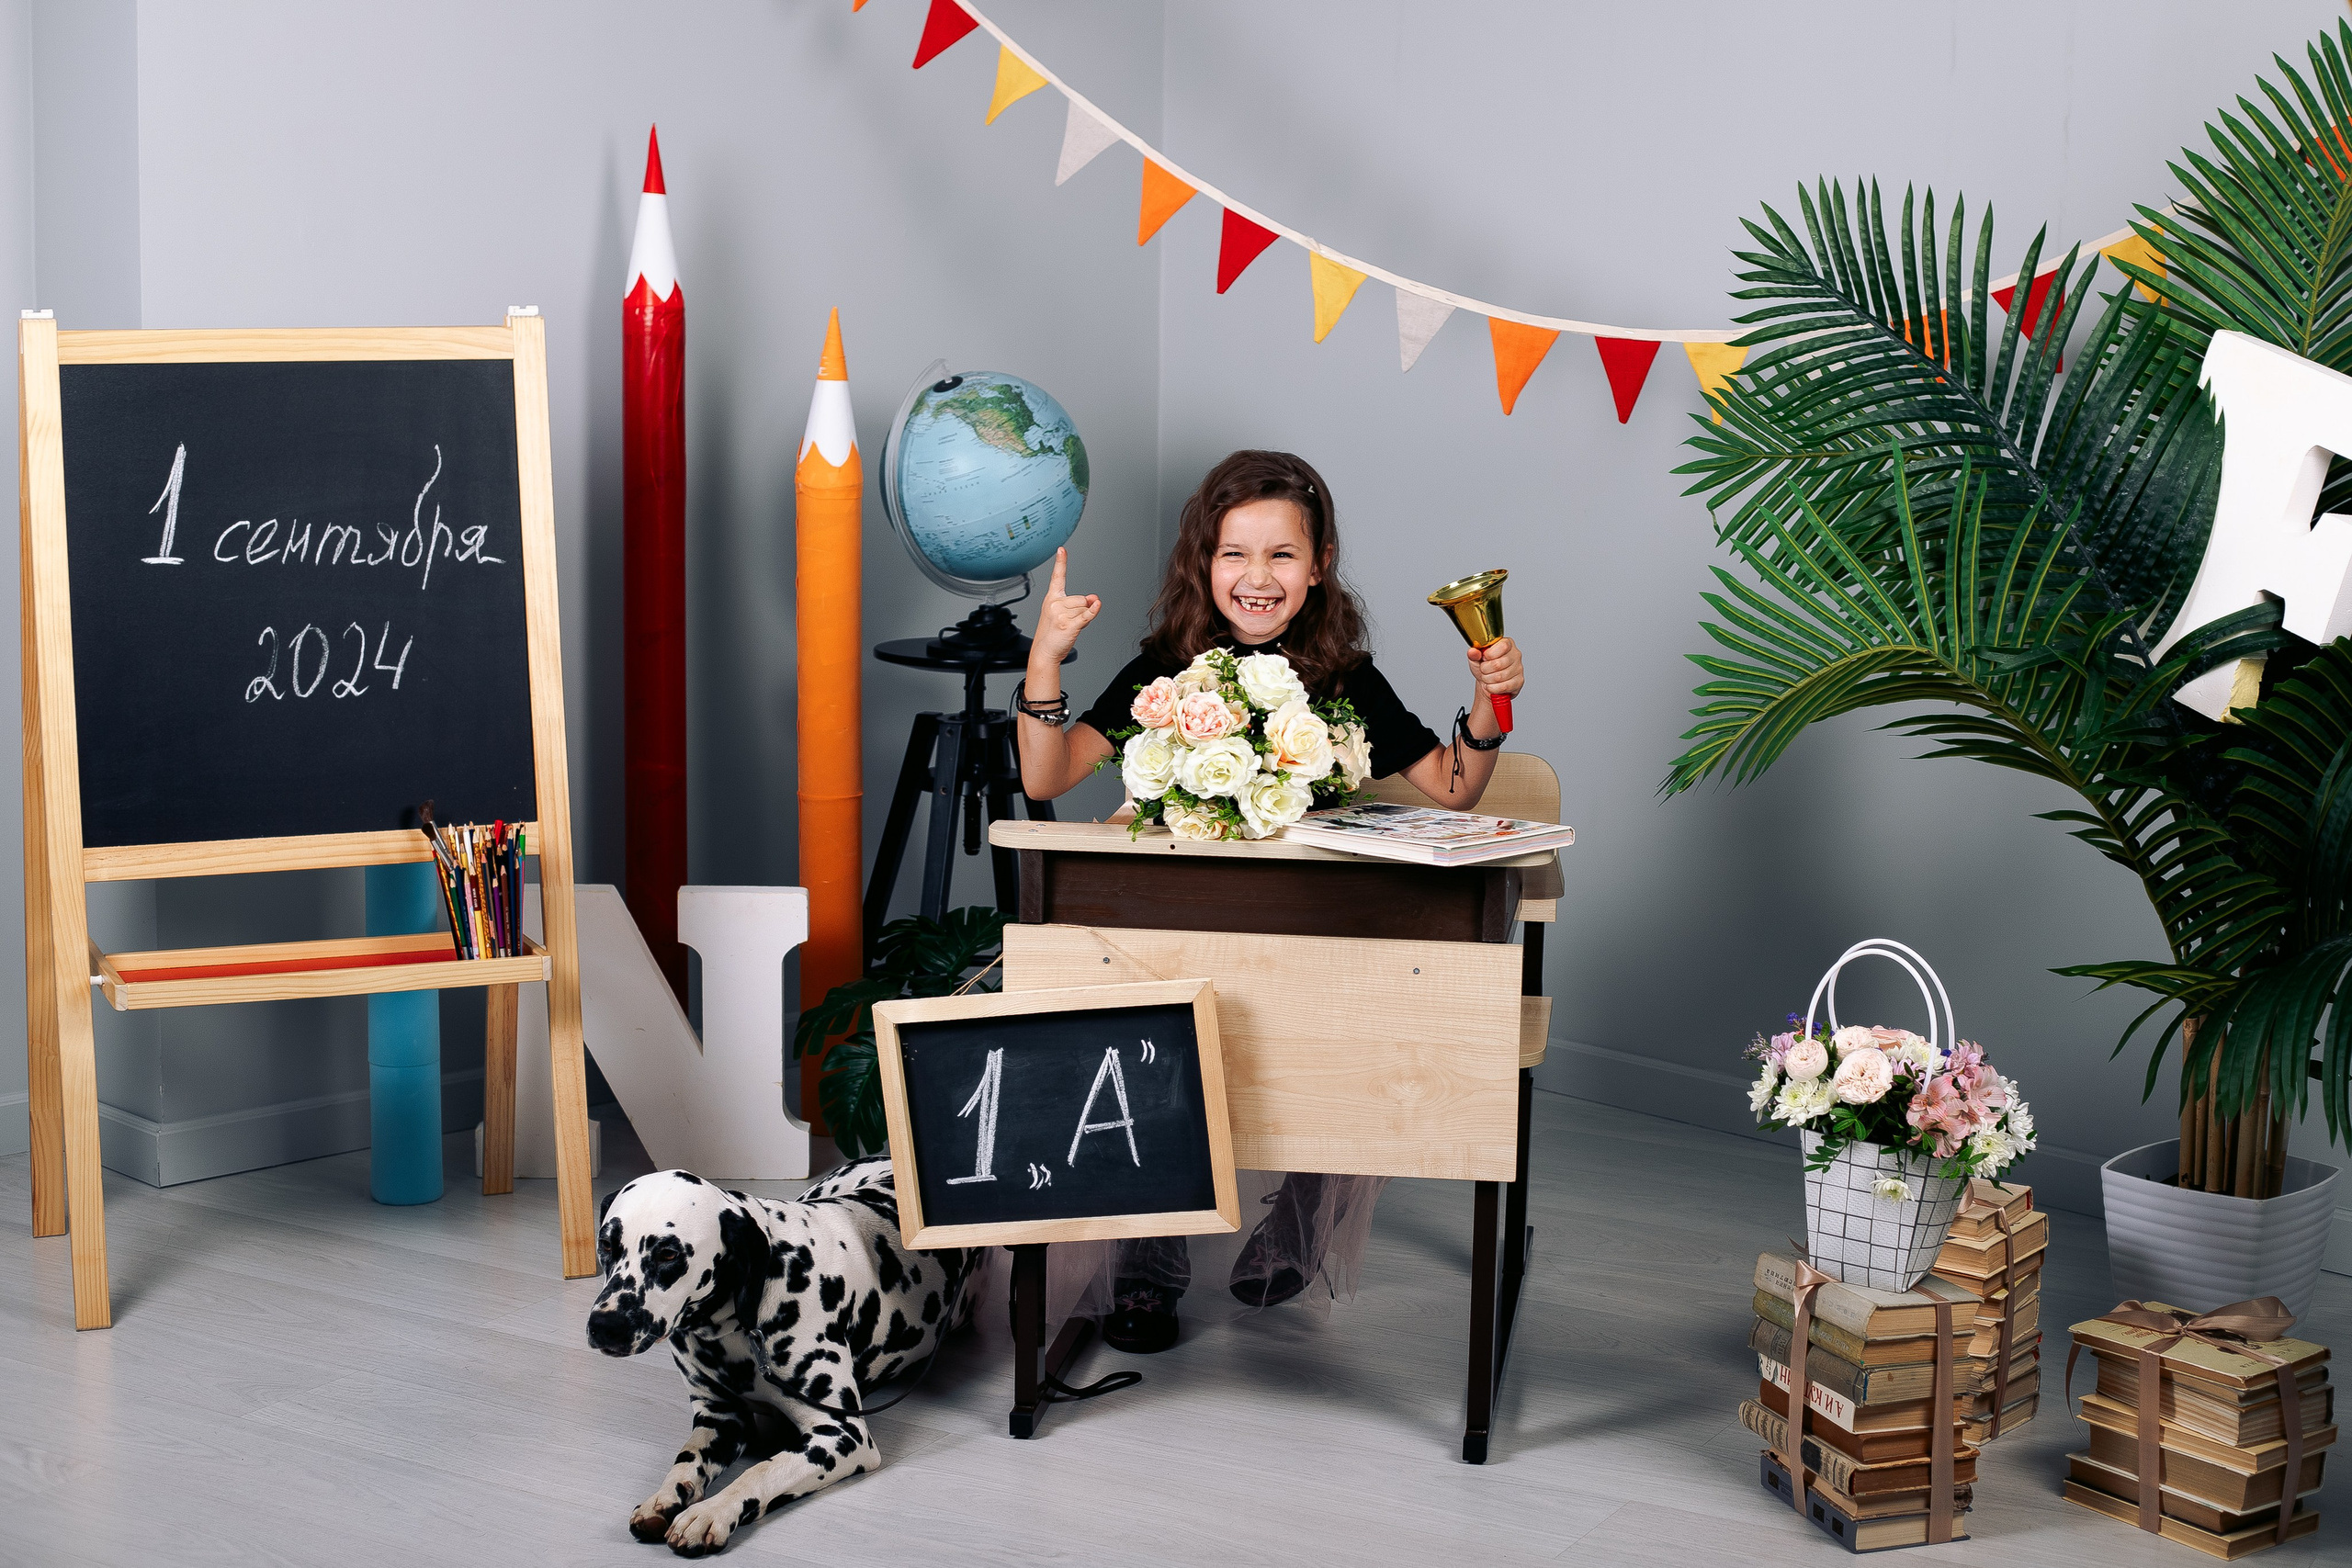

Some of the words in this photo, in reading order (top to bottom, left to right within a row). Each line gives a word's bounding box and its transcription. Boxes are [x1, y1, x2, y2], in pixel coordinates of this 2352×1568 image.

[140, 441, 187, 566] 1
[244, 621, 413, 703] 2024
[945, 1046, 1004, 1185] 1
